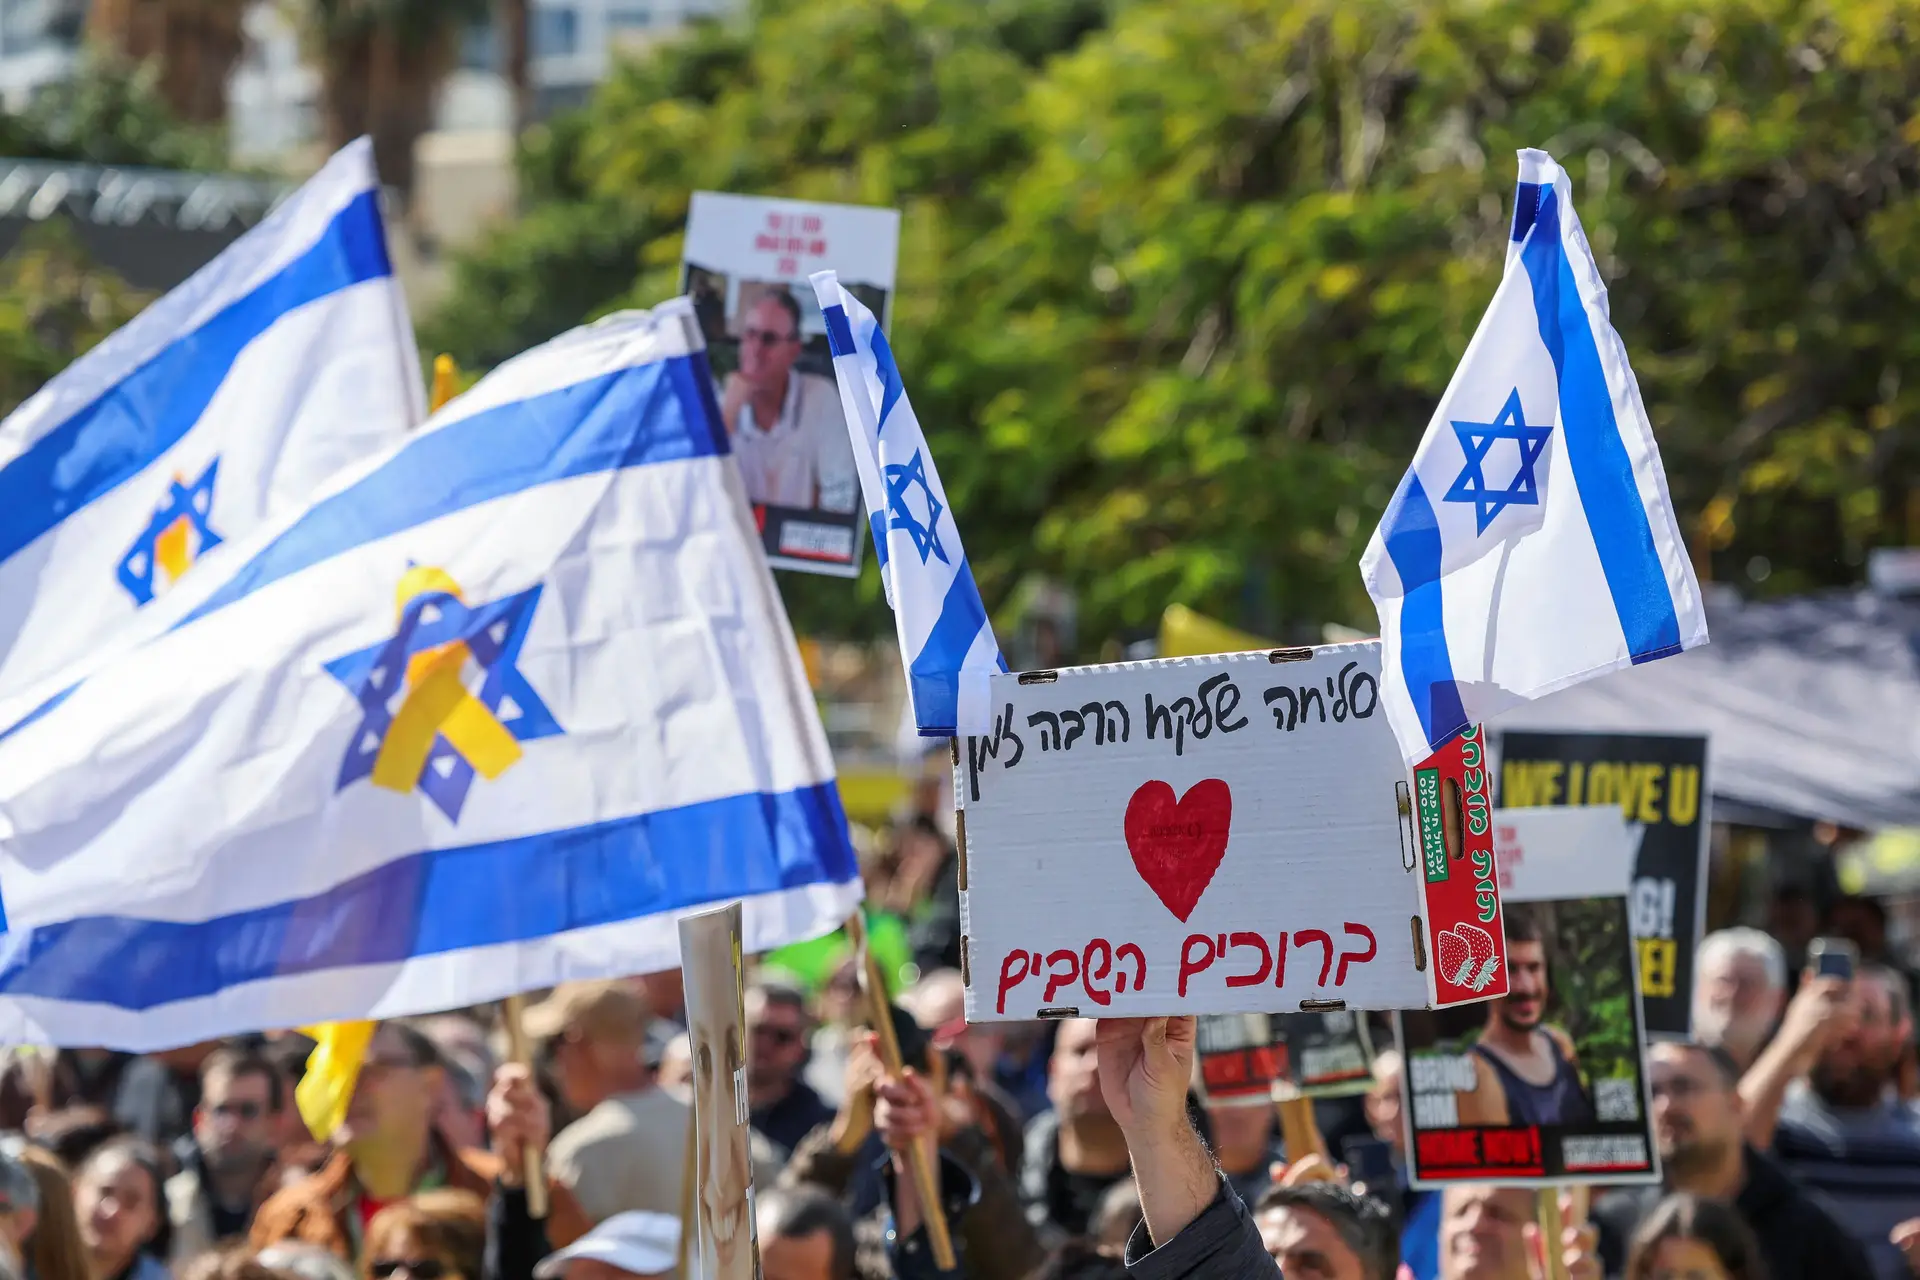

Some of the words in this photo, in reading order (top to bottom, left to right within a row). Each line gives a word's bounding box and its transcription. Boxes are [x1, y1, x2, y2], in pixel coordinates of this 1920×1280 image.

[1027, 700, 1130, 751] הרבה
[1145, 672, 1249, 756] שלקח
[1263, 661, 1378, 731] סליחה
[967, 703, 1025, 802] זמן
[1420, 777, 1436, 876] 050-5454291
[1432, 813, 1439, 827] חי
[1668, 764, 1699, 826] U
[1434, 831, 1445, 874] עבדול
[1471, 849, 1496, 923] תות
[996, 938, 1148, 1015] השבים
[1178, 922, 1378, 998] ברוכים
